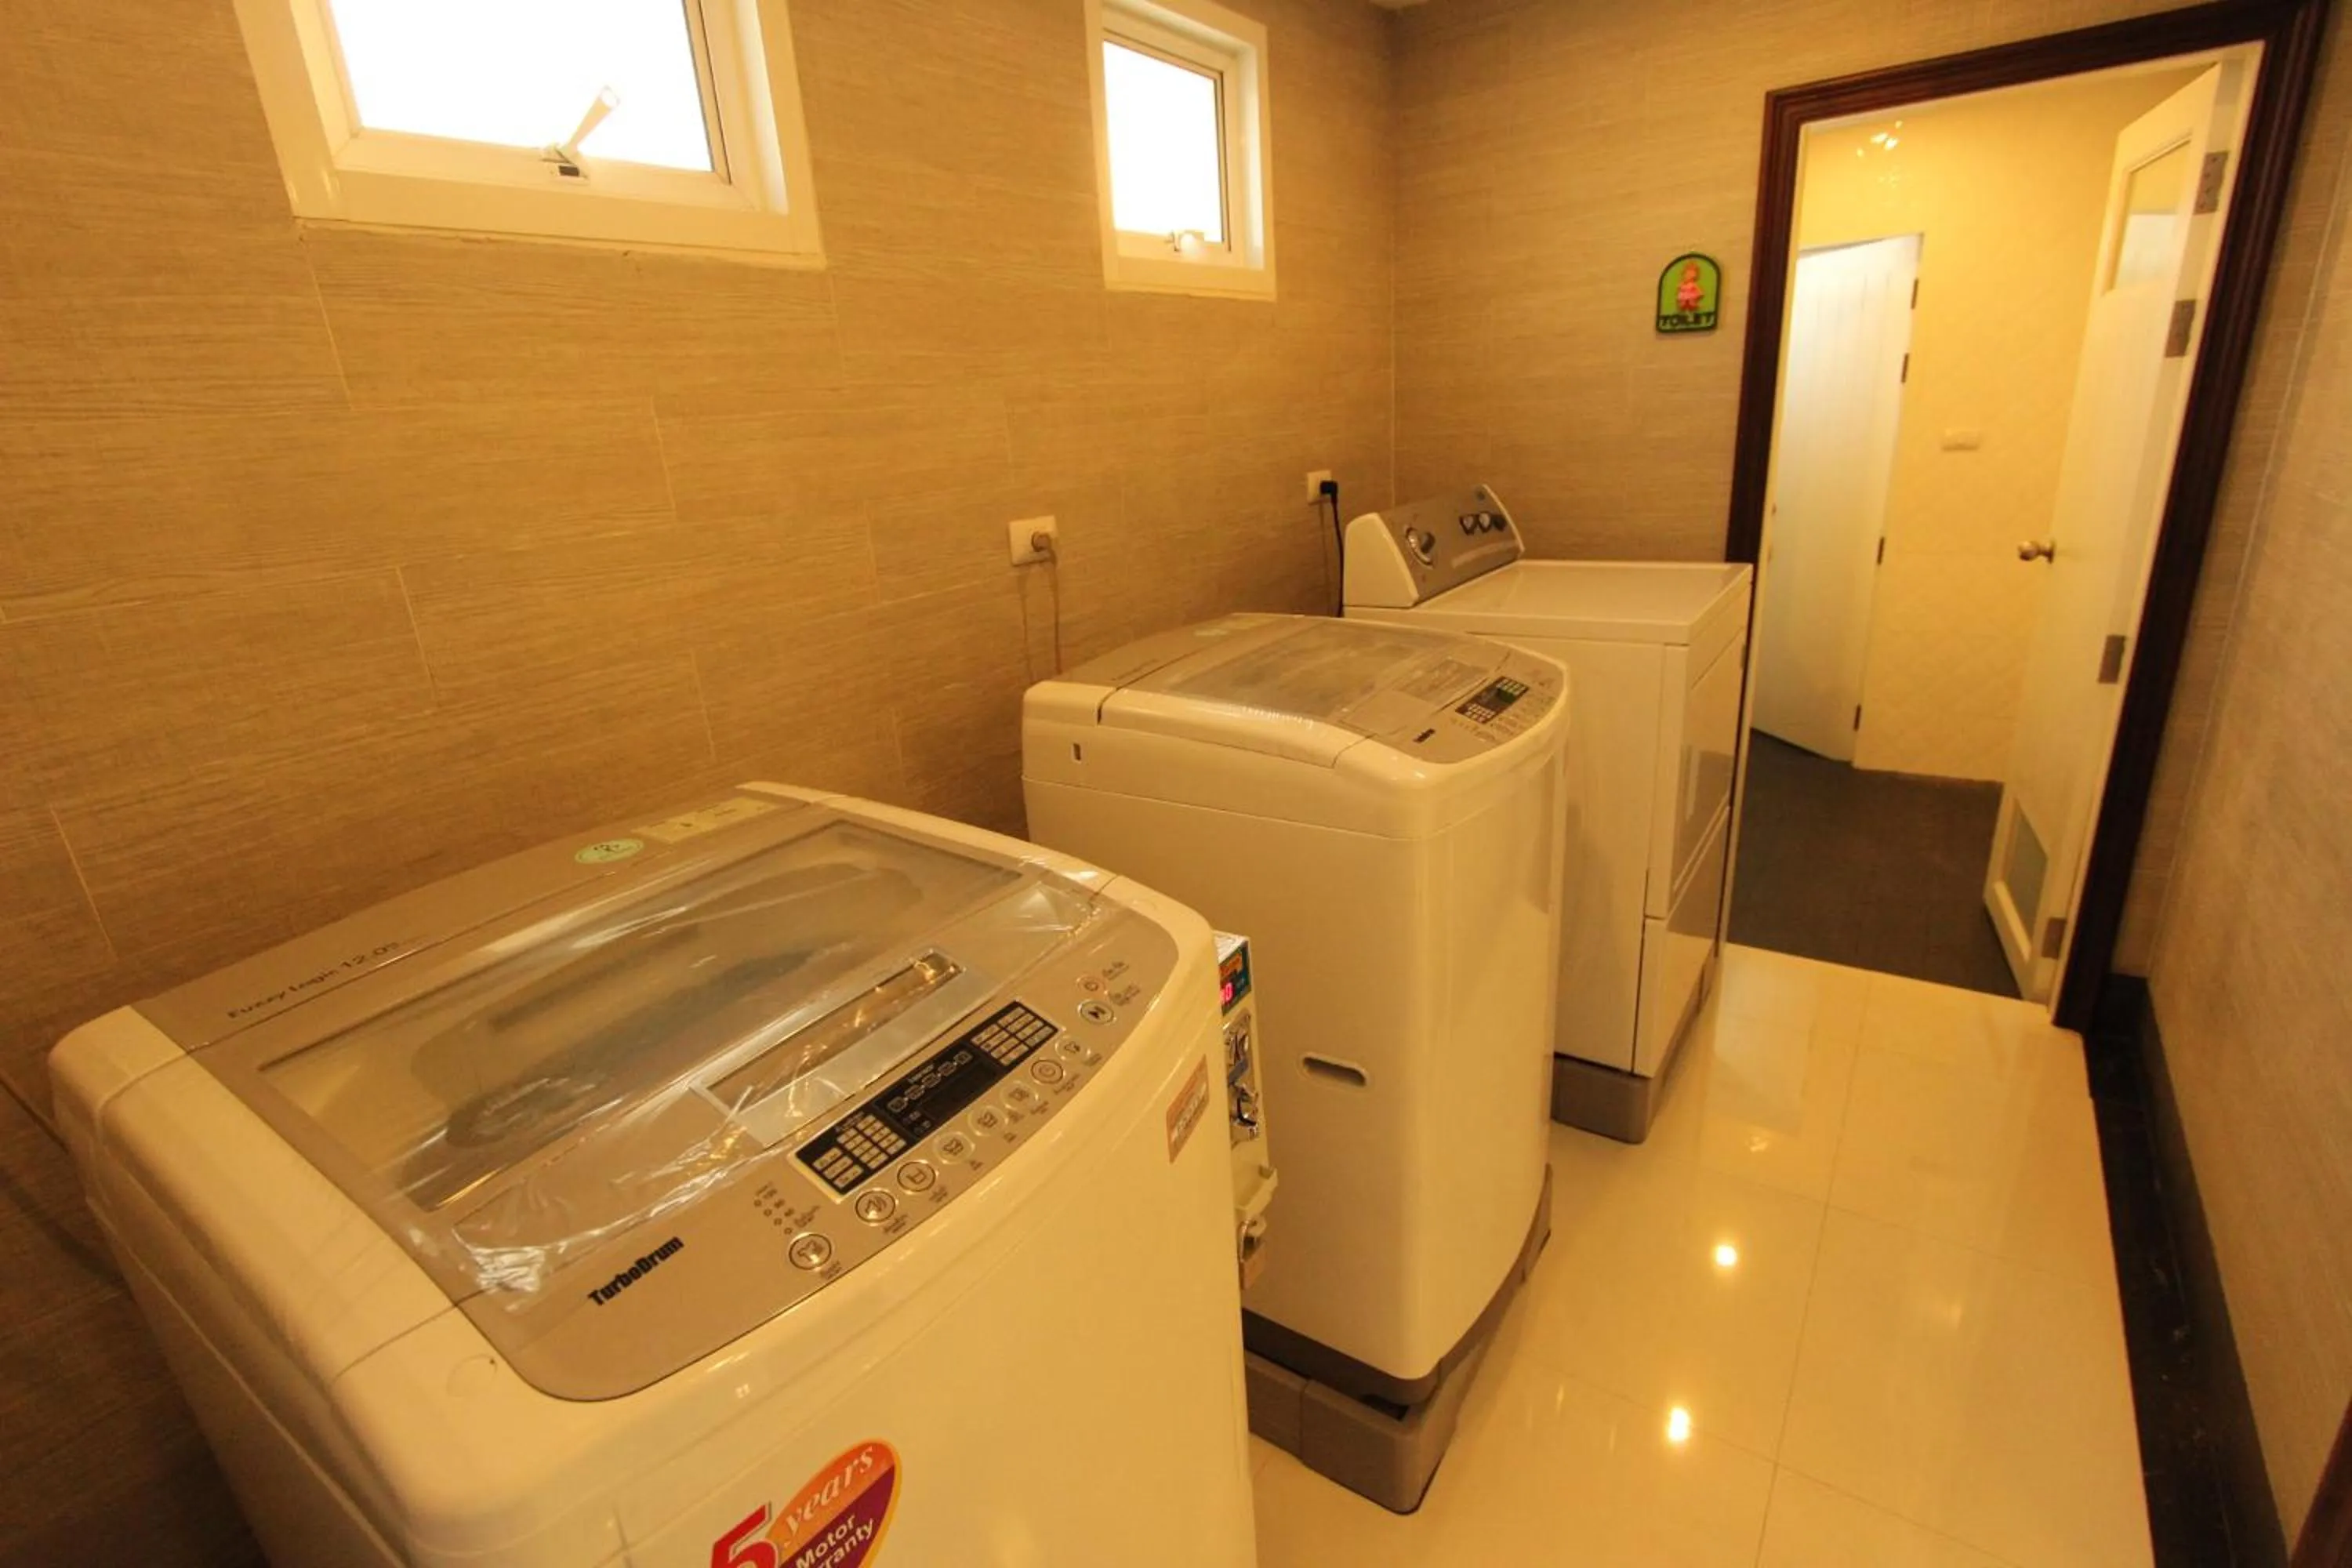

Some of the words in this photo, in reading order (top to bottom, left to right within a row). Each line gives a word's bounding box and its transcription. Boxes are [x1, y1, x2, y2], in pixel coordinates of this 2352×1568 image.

[1658, 312, 1715, 327] TOILET
[587, 1236, 684, 1305] TurboDrum
[710, 1502, 776, 1568] 5
[784, 1446, 873, 1548] years
[795, 1513, 855, 1568] Motor
